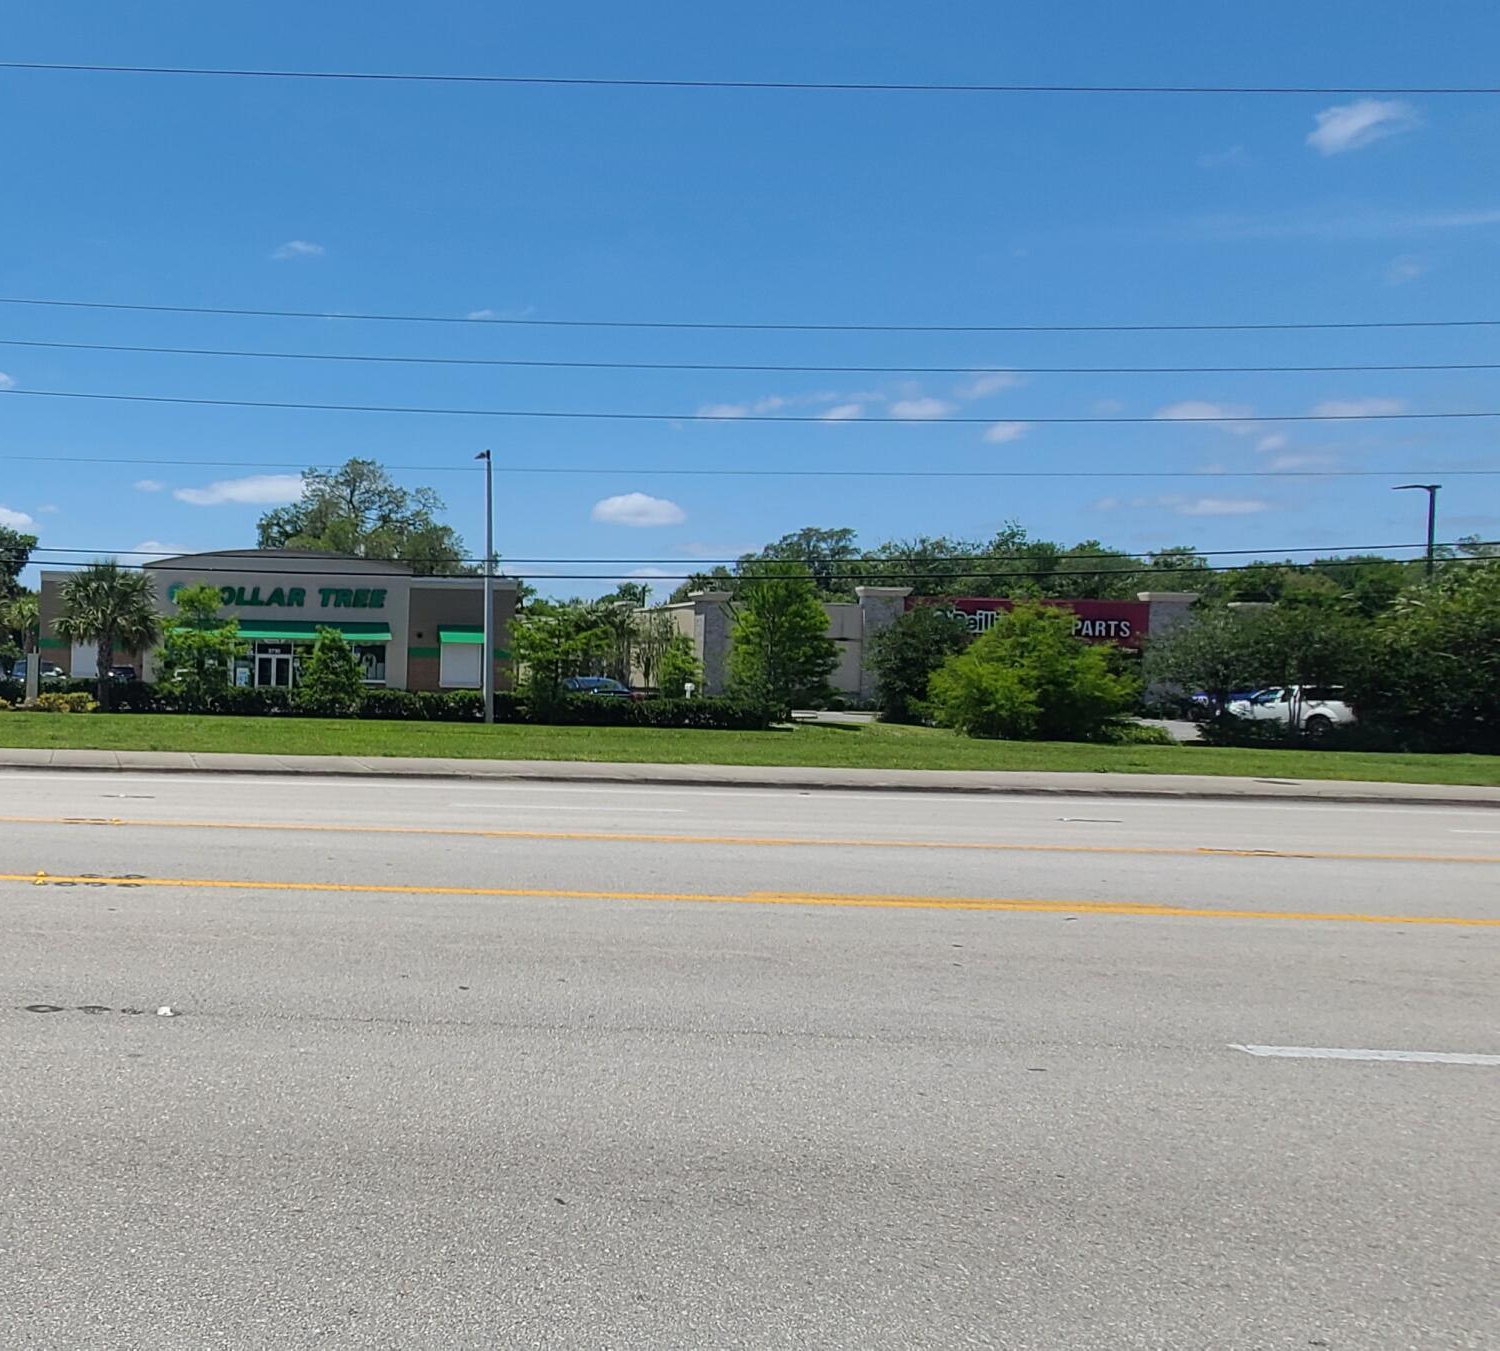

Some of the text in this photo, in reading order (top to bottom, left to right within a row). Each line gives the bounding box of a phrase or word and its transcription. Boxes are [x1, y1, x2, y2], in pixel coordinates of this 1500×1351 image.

[200, 586, 388, 608] OLLAR TREE
[1071, 620, 1131, 638] PARTS
